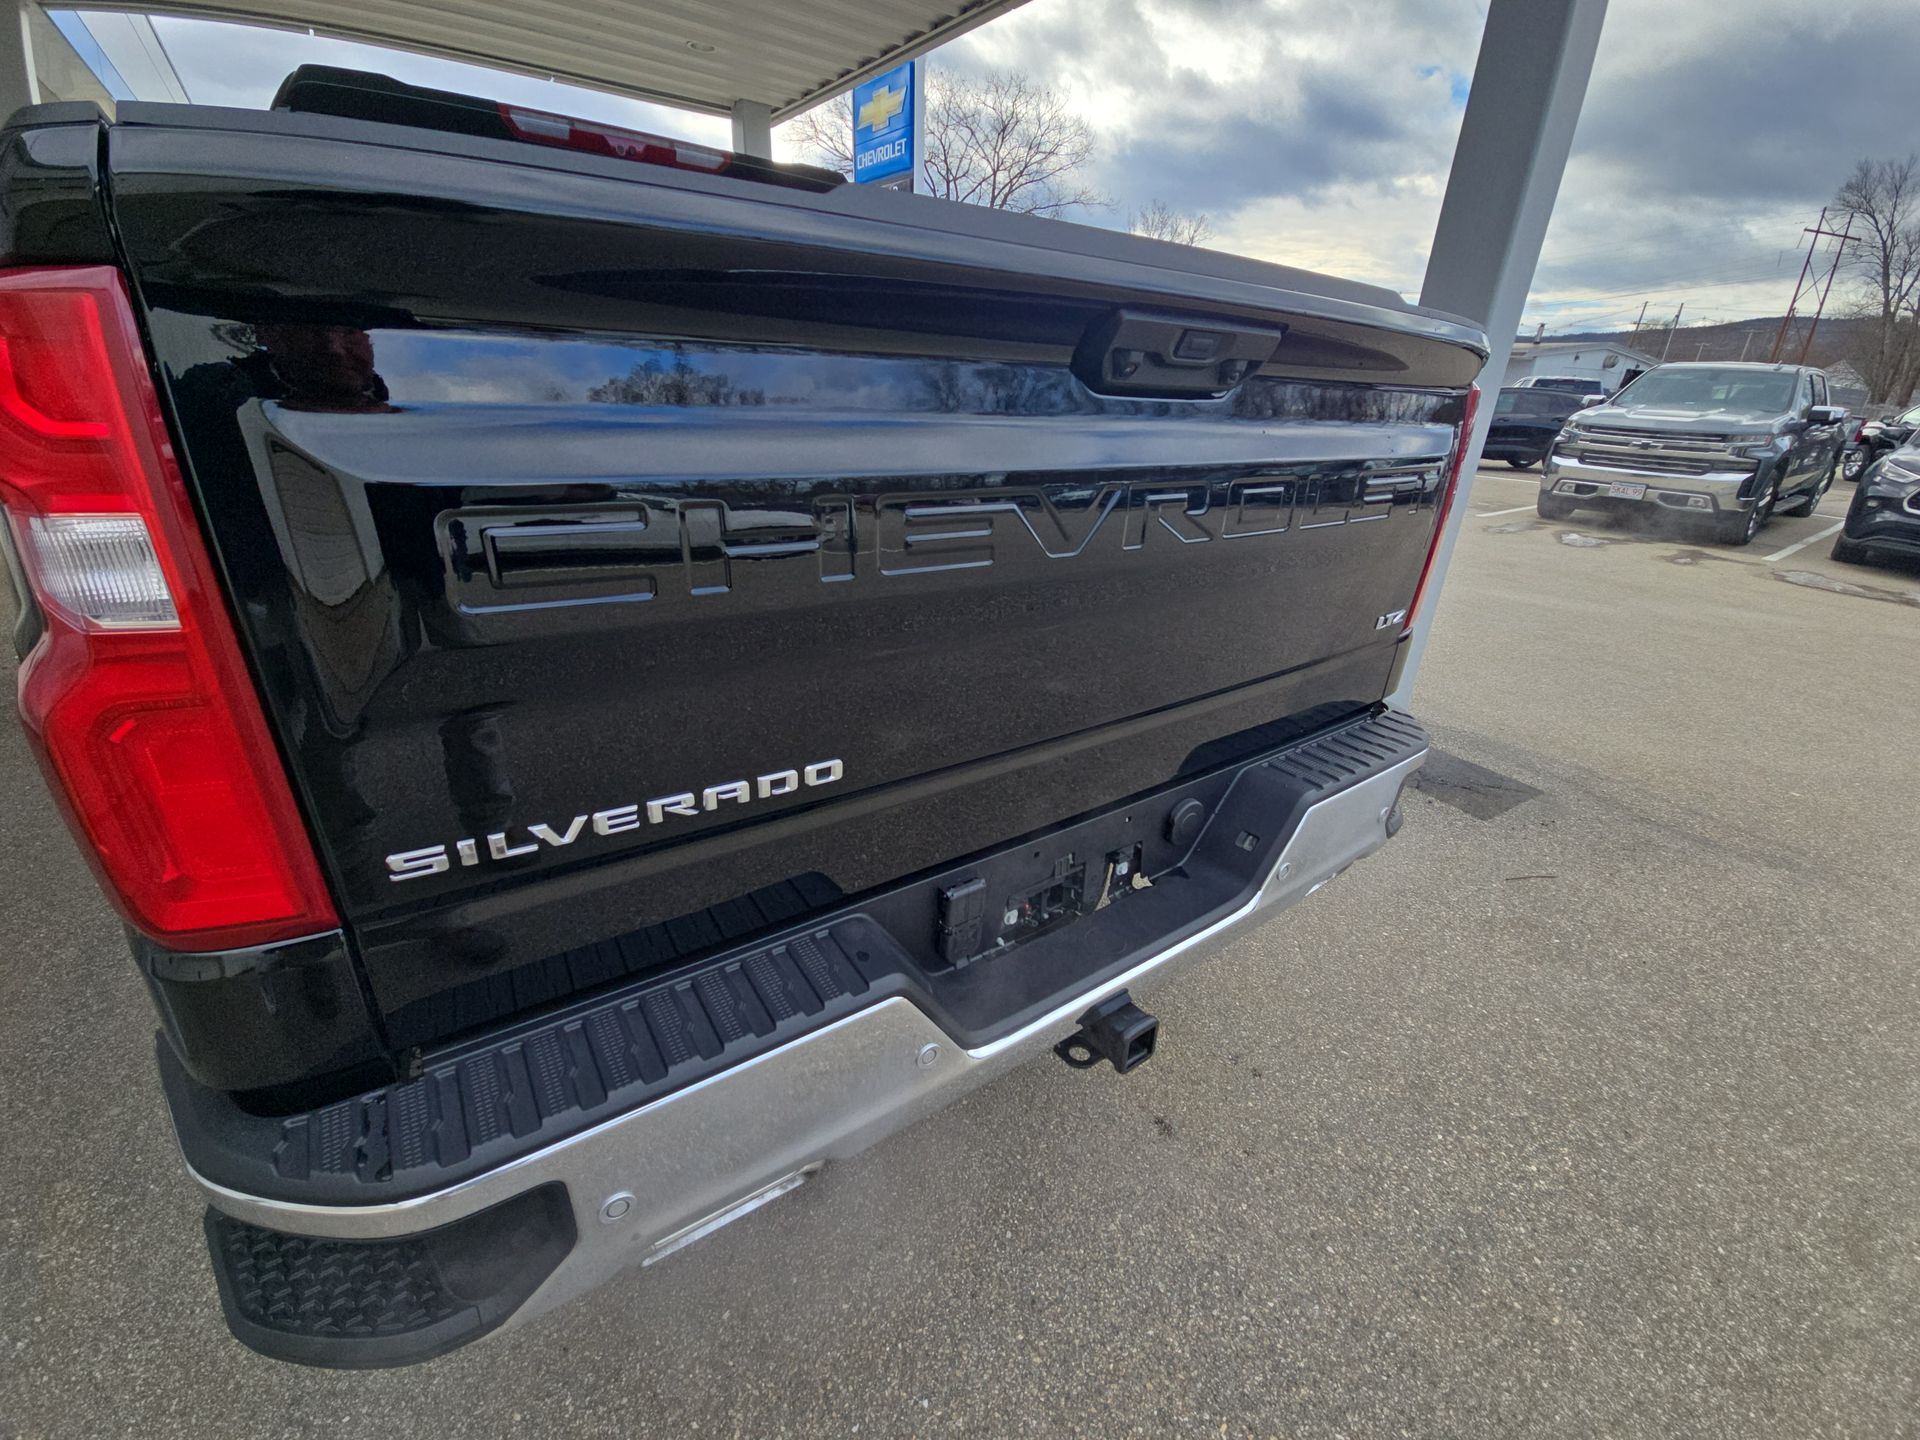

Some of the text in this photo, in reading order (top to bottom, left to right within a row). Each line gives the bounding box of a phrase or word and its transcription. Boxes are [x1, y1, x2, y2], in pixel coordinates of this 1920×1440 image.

[857, 138, 907, 169] CHEVROLET
[433, 463, 1443, 616] CHEVROLET
[1375, 609, 1406, 630] LTZ
[385, 758, 843, 882] SILVERADO
